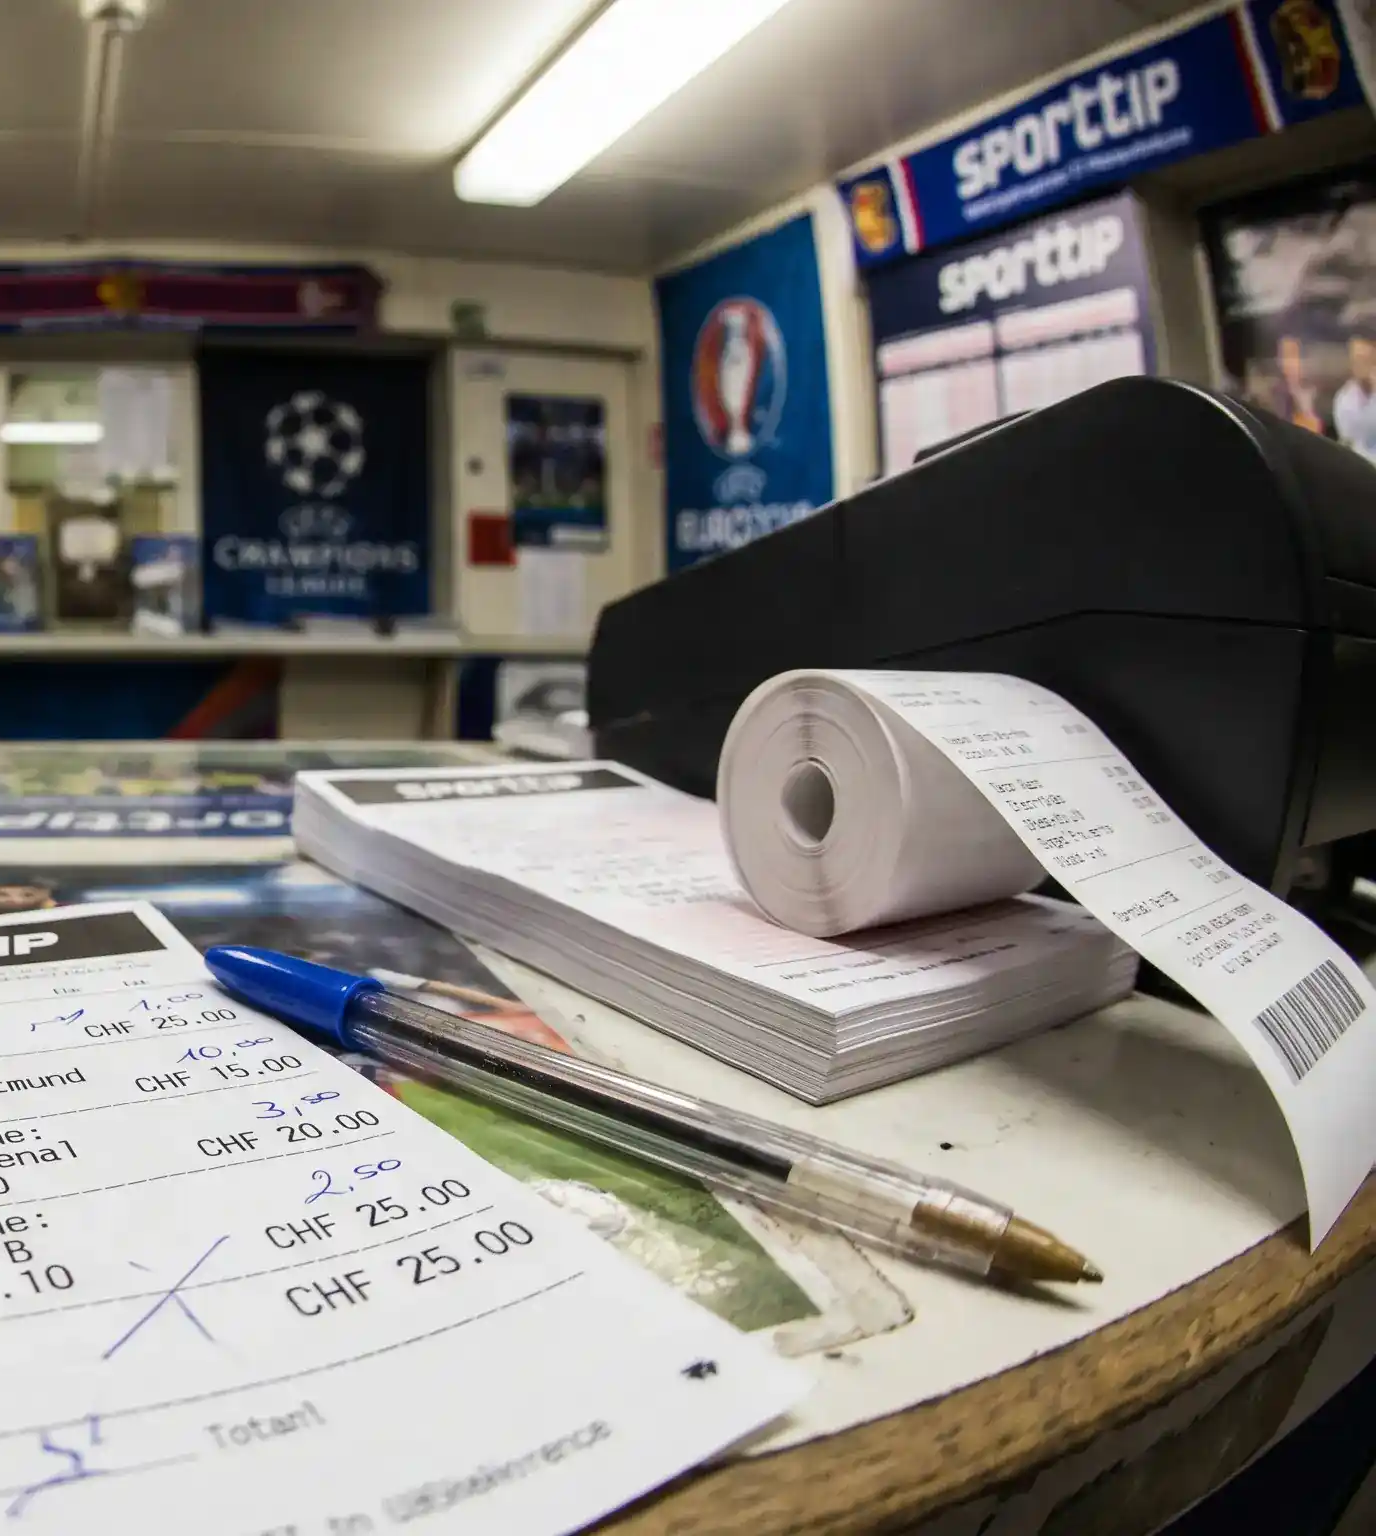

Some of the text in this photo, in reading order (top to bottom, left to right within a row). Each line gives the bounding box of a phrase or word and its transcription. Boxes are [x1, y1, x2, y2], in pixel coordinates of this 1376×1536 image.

[84, 1008, 237, 1039] CHF 25.00
[135, 1055, 302, 1093] CHF 15.00
[197, 1110, 380, 1157] CHF 20.00
[265, 1179, 470, 1249] CHF 25.00
[285, 1220, 534, 1317] CHF 25.00
